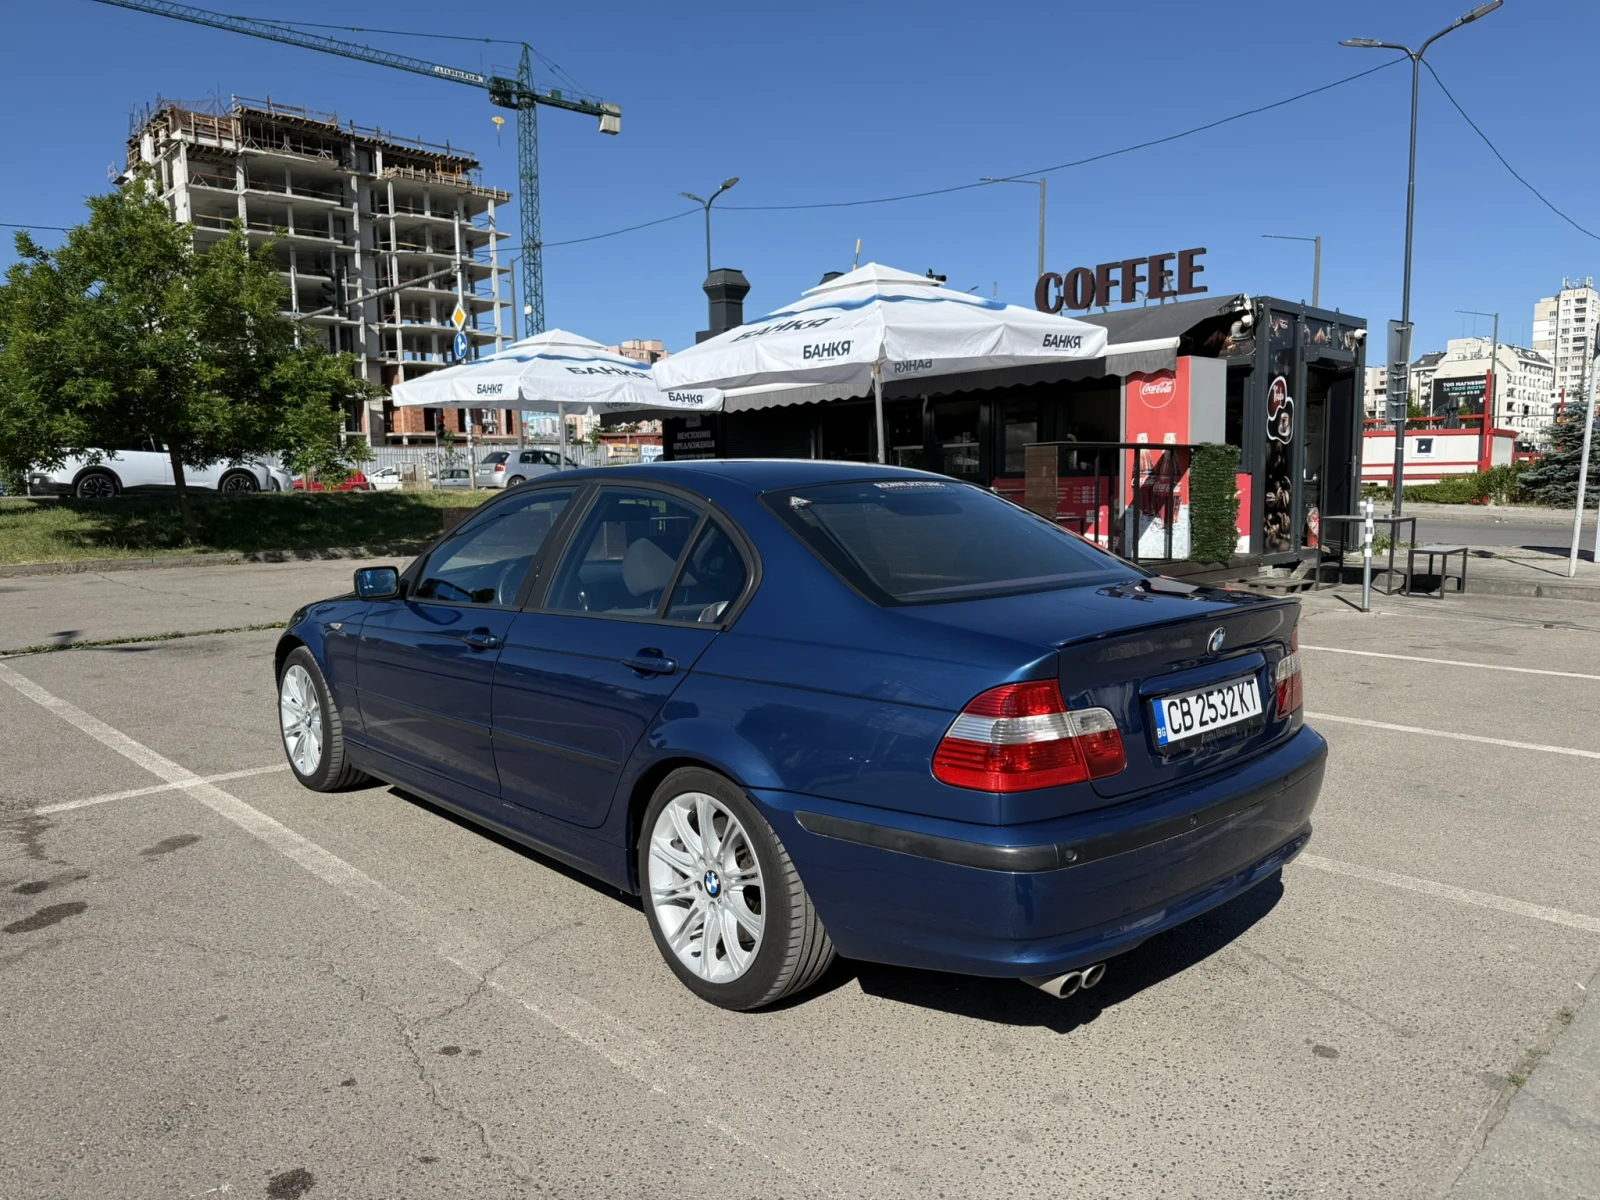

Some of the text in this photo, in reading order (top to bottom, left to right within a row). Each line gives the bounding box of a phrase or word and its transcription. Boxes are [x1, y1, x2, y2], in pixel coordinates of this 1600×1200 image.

[1034, 247, 1208, 314] COFFEE
[729, 317, 834, 343] БАНКЯ
[1042, 333, 1082, 349] БАНКЯ
[803, 340, 851, 360] БАНКЯ
[565, 366, 653, 380] БАНКЯ
[477, 383, 503, 394] БАНКЯ
[1141, 381, 1173, 395] Coca-Cola
[668, 391, 704, 404] БАНКЯ
[1167, 679, 1257, 735] CB 2532 KT
[1157, 727, 1167, 738] BG
